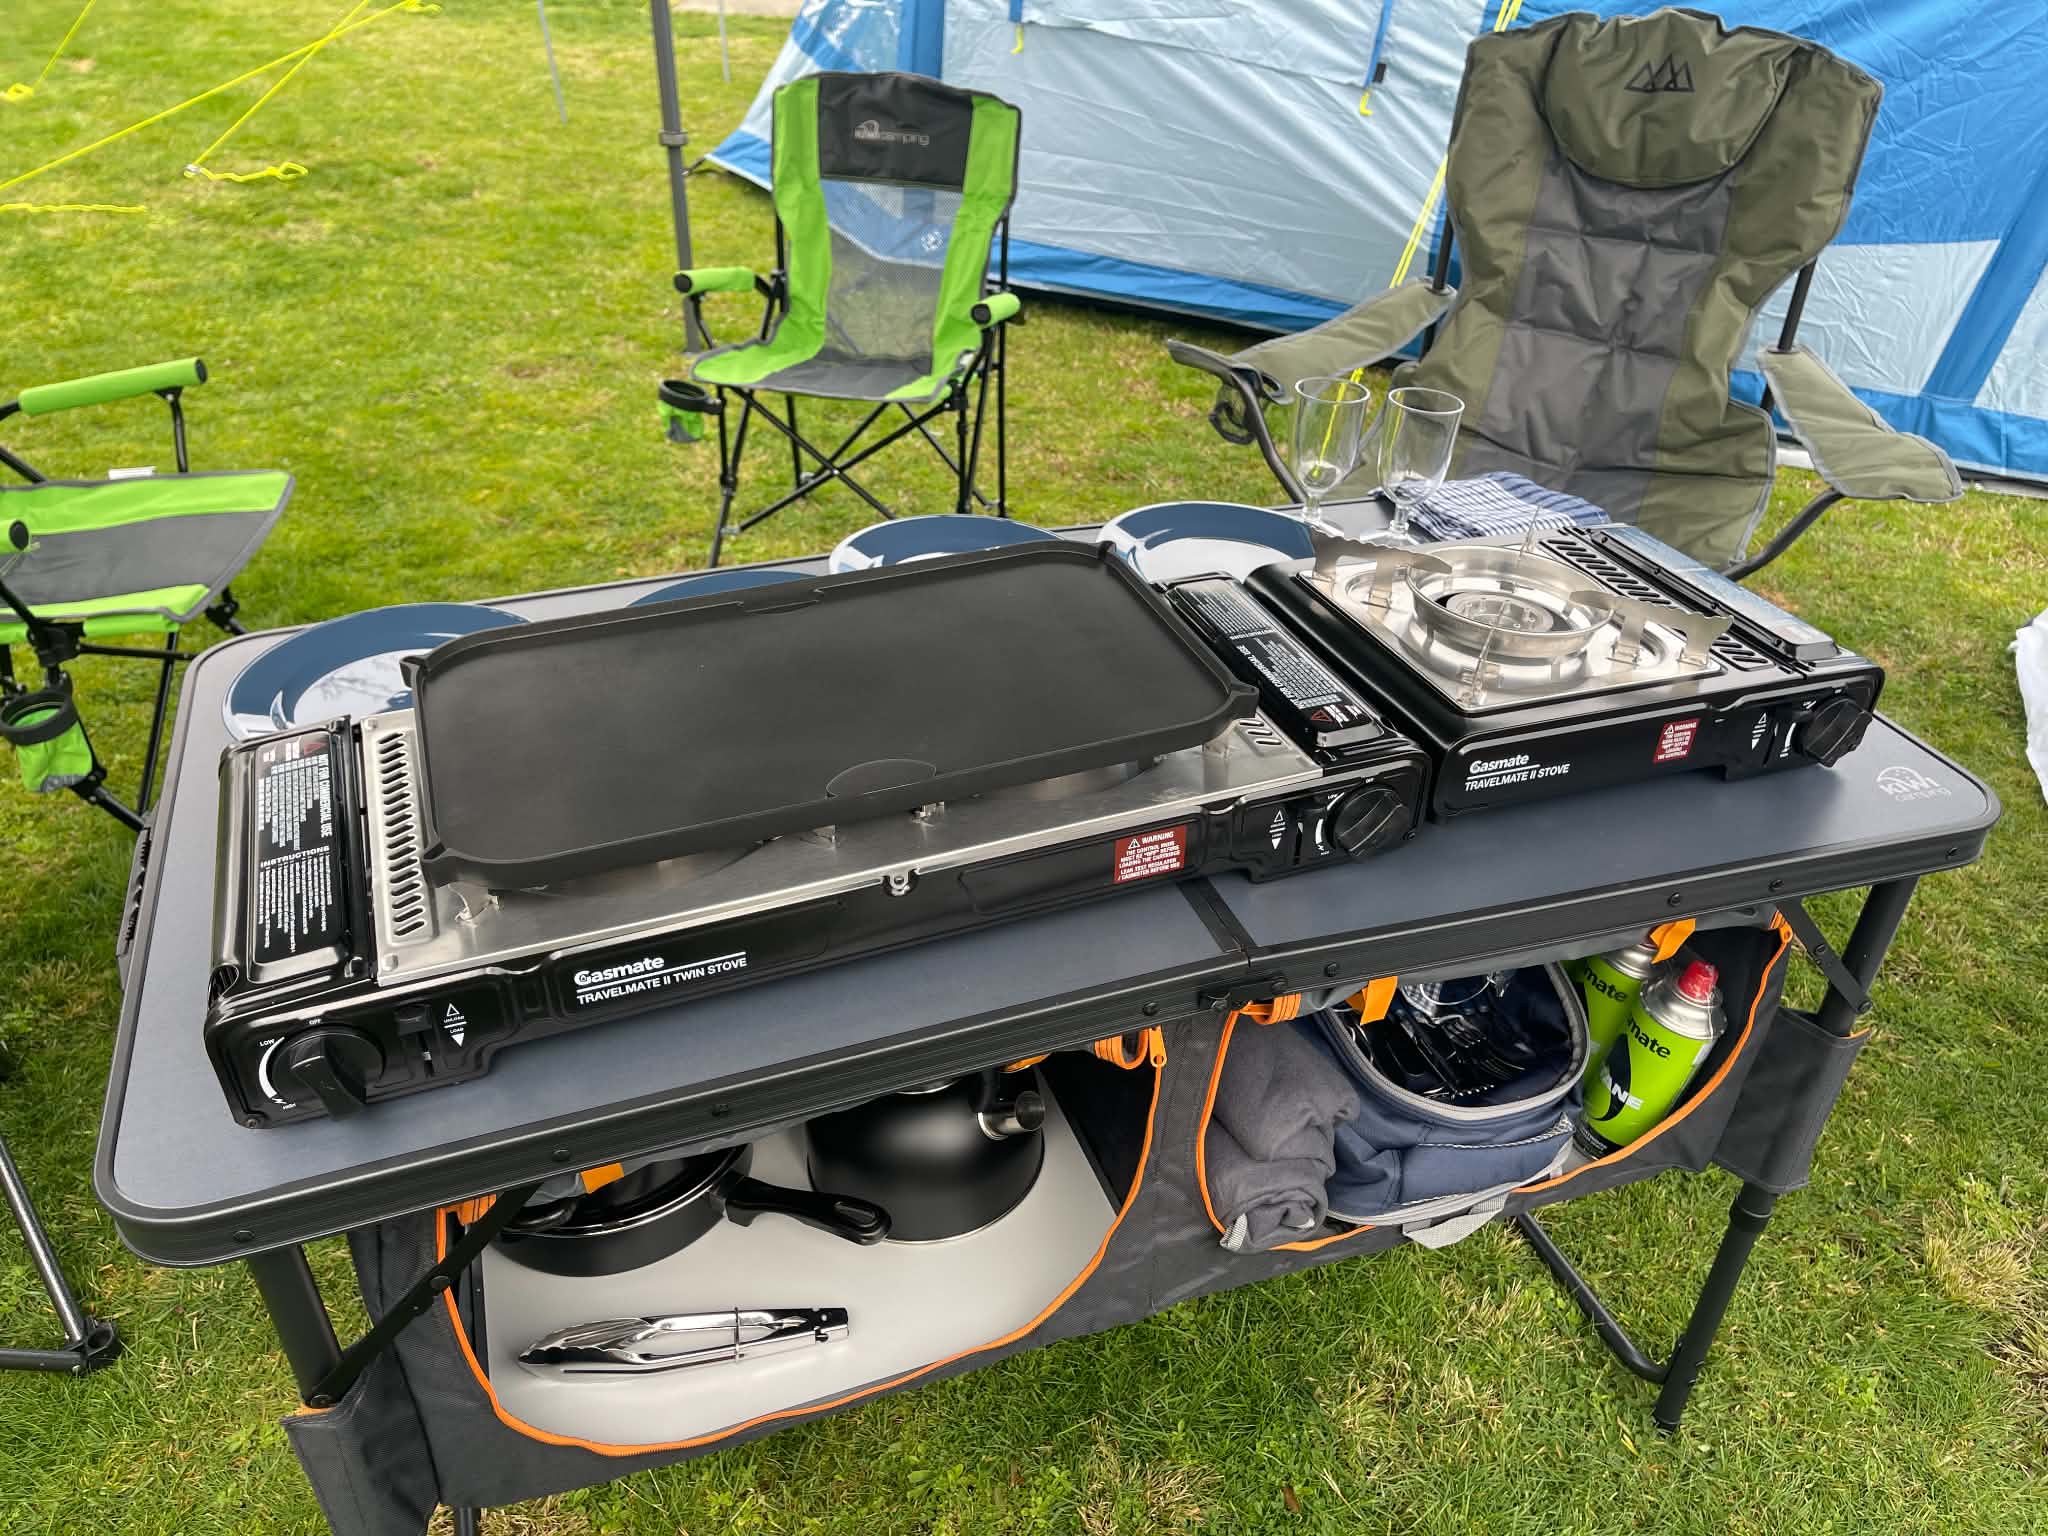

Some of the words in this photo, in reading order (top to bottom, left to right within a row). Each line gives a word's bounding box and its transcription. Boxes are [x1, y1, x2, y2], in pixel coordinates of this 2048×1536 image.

[1469, 754, 1530, 774] Gasmate
[1464, 771, 1529, 791] TRAVELMATE
[1529, 770, 1537, 780] II
[1537, 763, 1571, 778] STOVE
[1141, 831, 1174, 845] WARNING
[260, 845, 329, 869] INSTRUCTIONS
[573, 956, 665, 986] Gasmate
[576, 977, 661, 1005] TRAVELMATE
[663, 975, 671, 985] II
[673, 968, 705, 983] TWIN
[707, 957, 748, 975] STOVE
[259, 1038, 275, 1047] LOW
